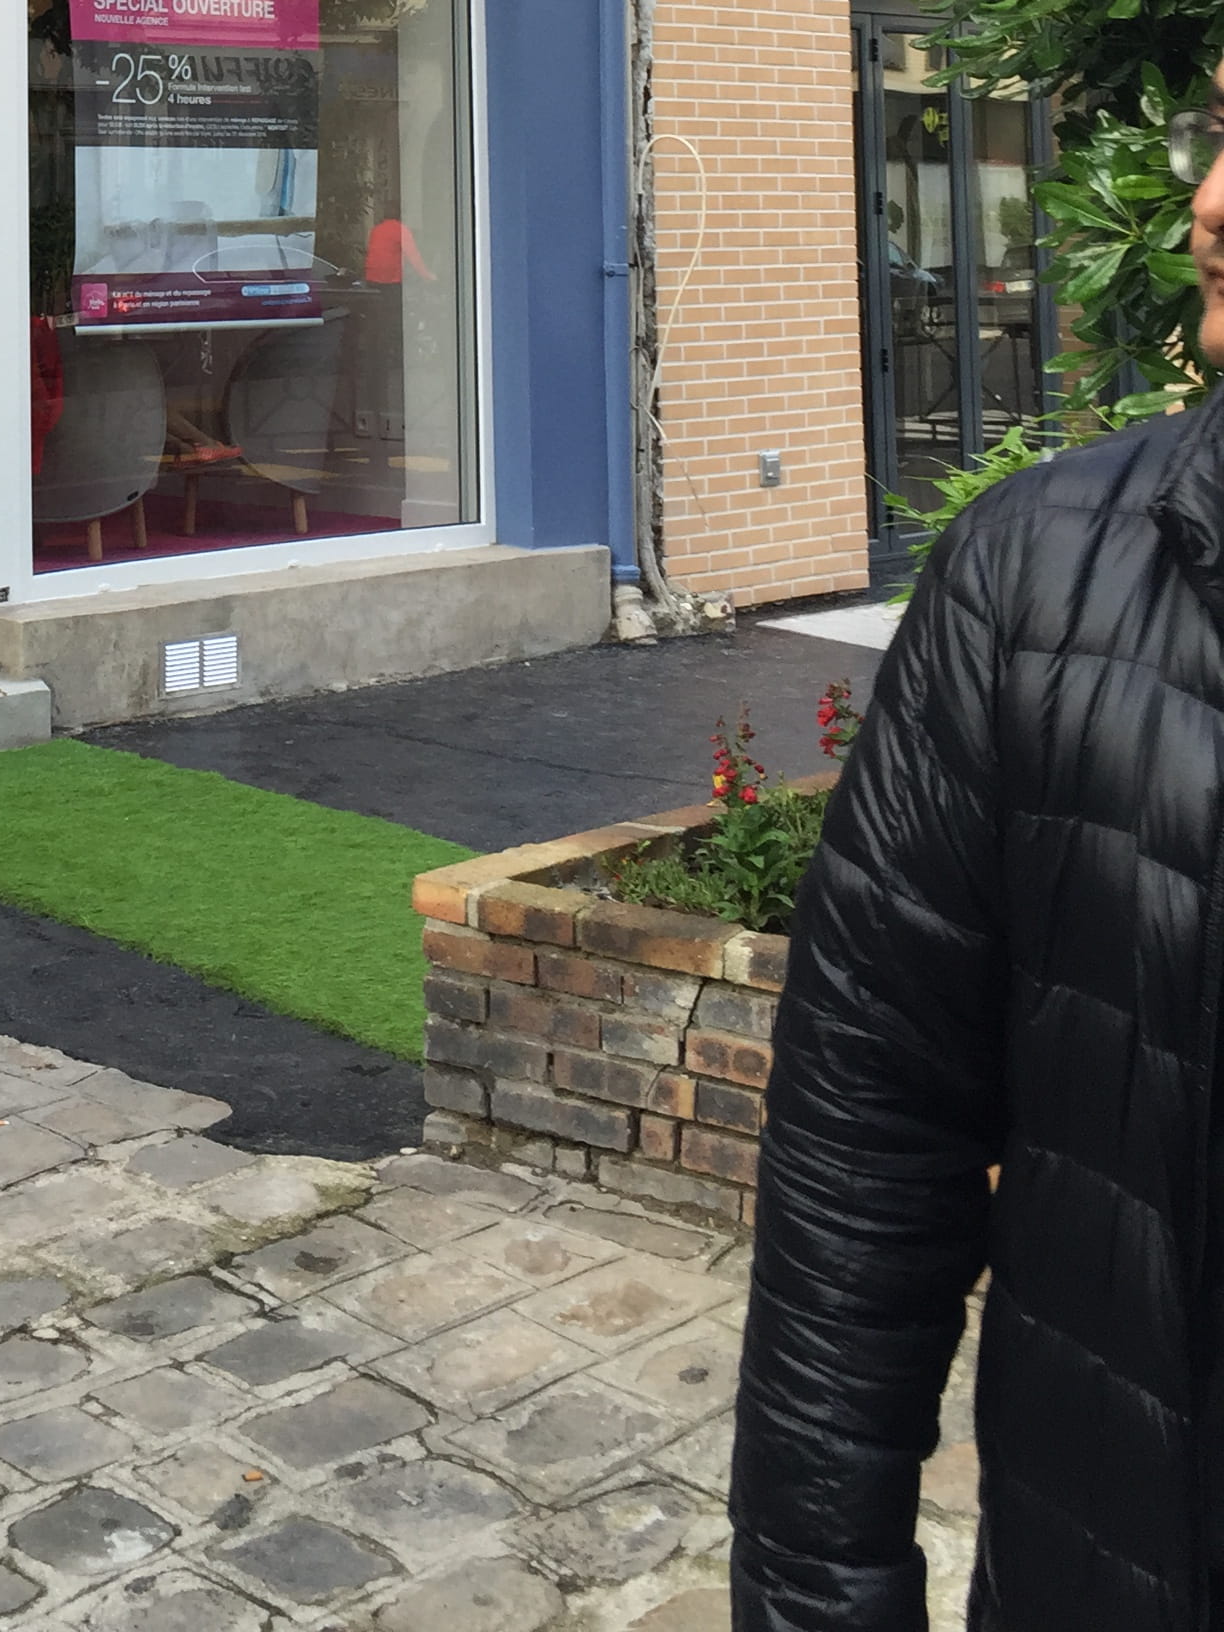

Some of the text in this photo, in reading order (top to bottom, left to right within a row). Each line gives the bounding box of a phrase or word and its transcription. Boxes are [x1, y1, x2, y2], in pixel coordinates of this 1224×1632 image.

[94, 13, 169, 27] NOUVELLE AGENCE
[167, 94, 212, 106] 4 heures
